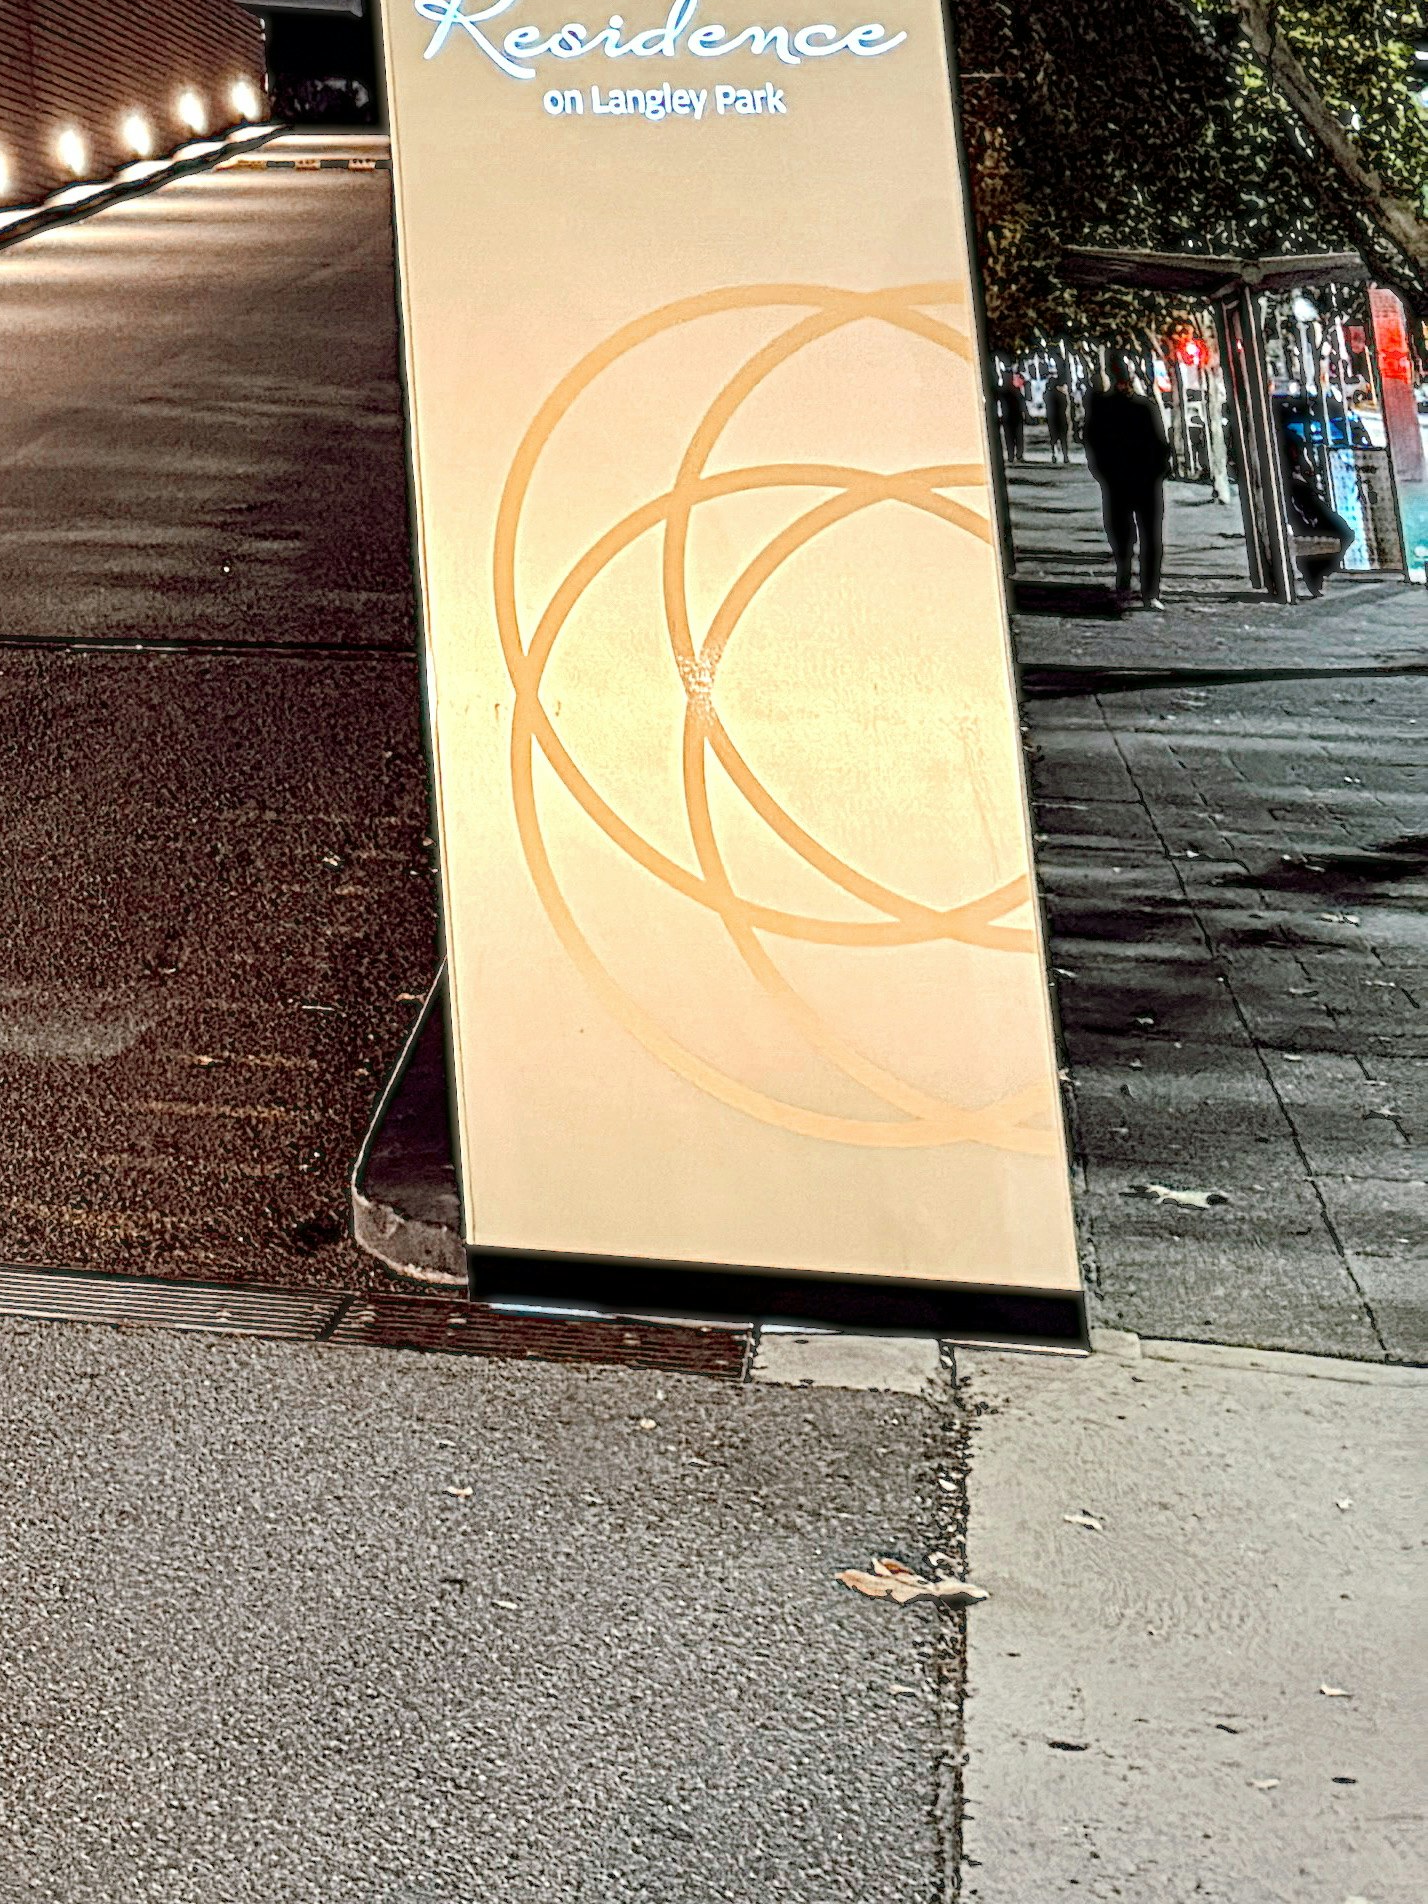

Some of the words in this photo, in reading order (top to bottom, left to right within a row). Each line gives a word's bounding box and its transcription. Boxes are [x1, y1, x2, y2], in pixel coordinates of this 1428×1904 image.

[542, 89, 584, 116] on
[590, 82, 708, 121] Langley
[715, 82, 788, 116] Park
